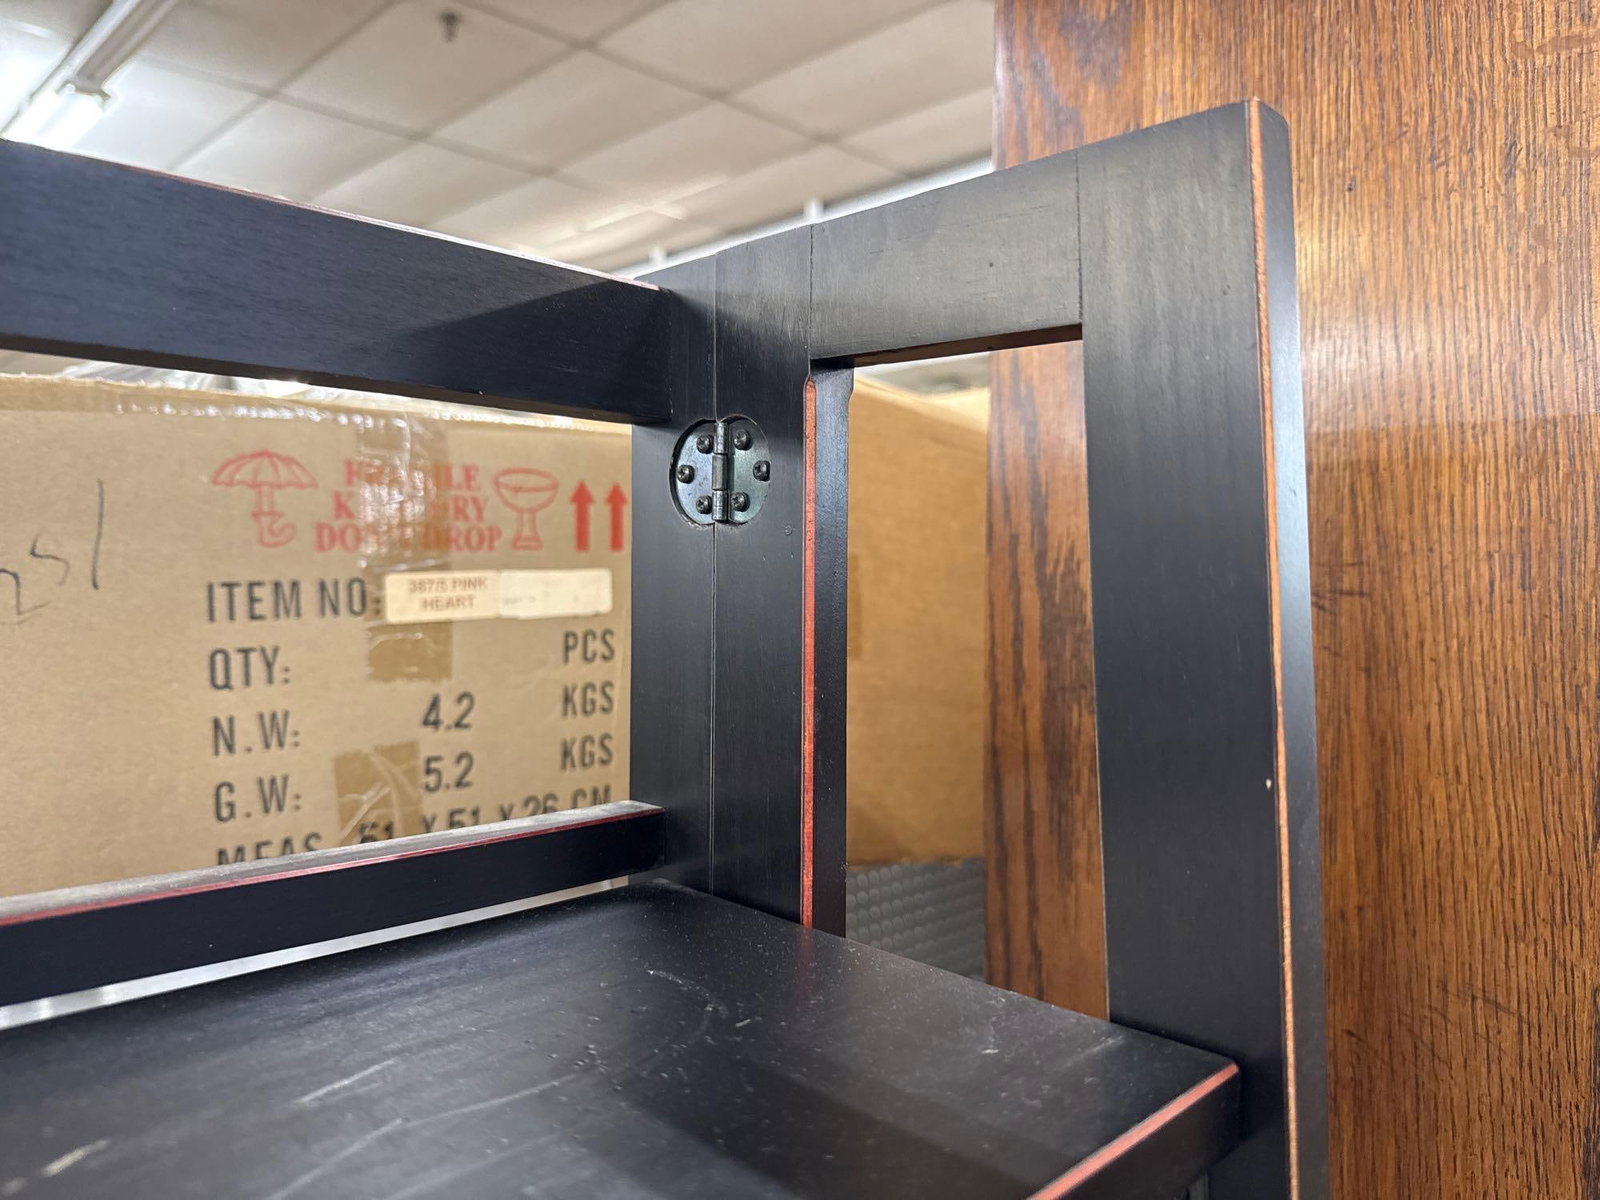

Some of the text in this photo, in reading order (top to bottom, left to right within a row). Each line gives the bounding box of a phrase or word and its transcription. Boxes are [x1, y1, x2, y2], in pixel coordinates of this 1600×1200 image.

[314, 521, 363, 553] DO
[207, 580, 302, 623] ITEM
[422, 594, 477, 612] HEART
[451, 576, 489, 593] PINK
[209, 629, 616, 691] QTY: PCS
[421, 691, 476, 732] 4.2
[561, 680, 616, 719] KGS
[422, 751, 475, 794] 5.2
[560, 733, 615, 772] KGS
